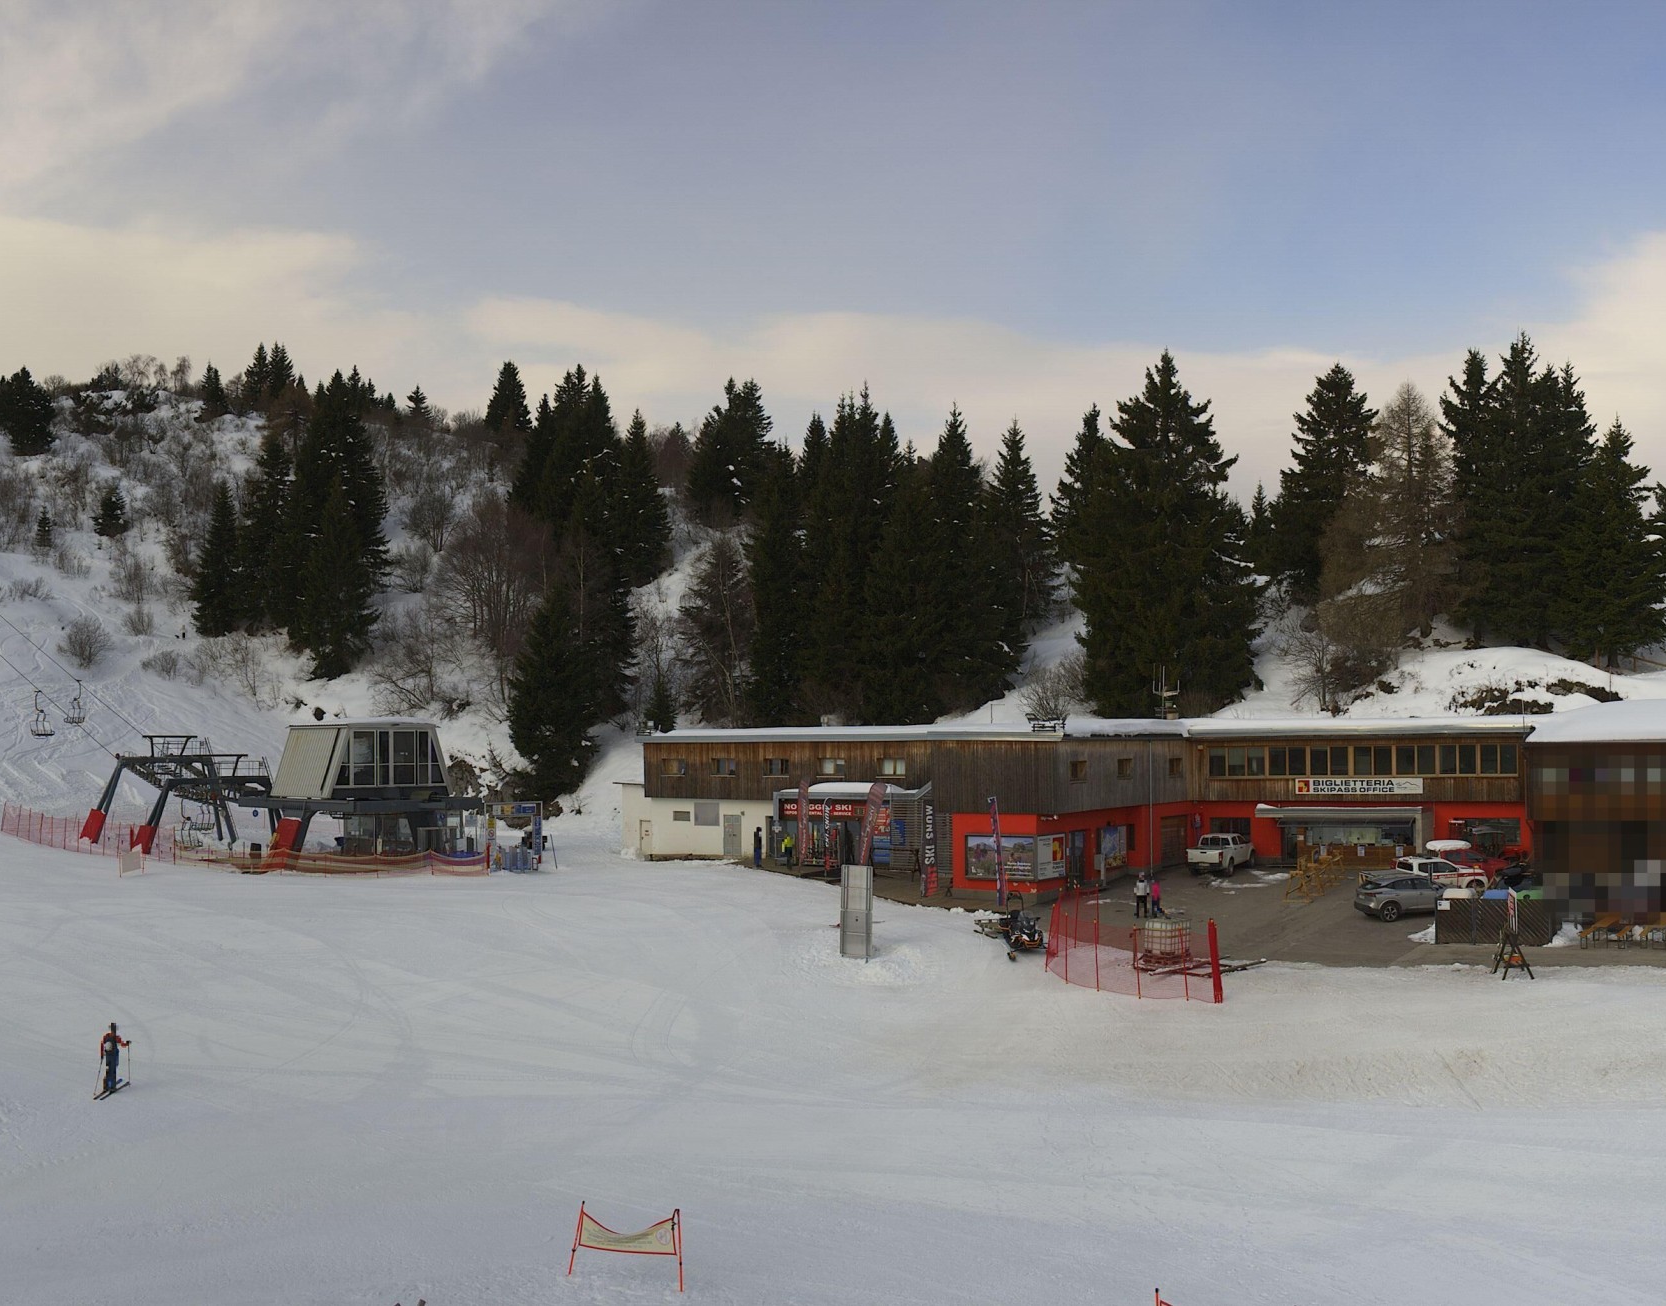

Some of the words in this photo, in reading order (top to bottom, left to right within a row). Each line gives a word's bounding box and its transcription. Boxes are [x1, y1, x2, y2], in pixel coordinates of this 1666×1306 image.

[1313, 779, 1395, 787] BIGLIETTERIA
[835, 803, 852, 811] SKI
[925, 805, 933, 838] SNOW
[925, 845, 935, 865] SKI
